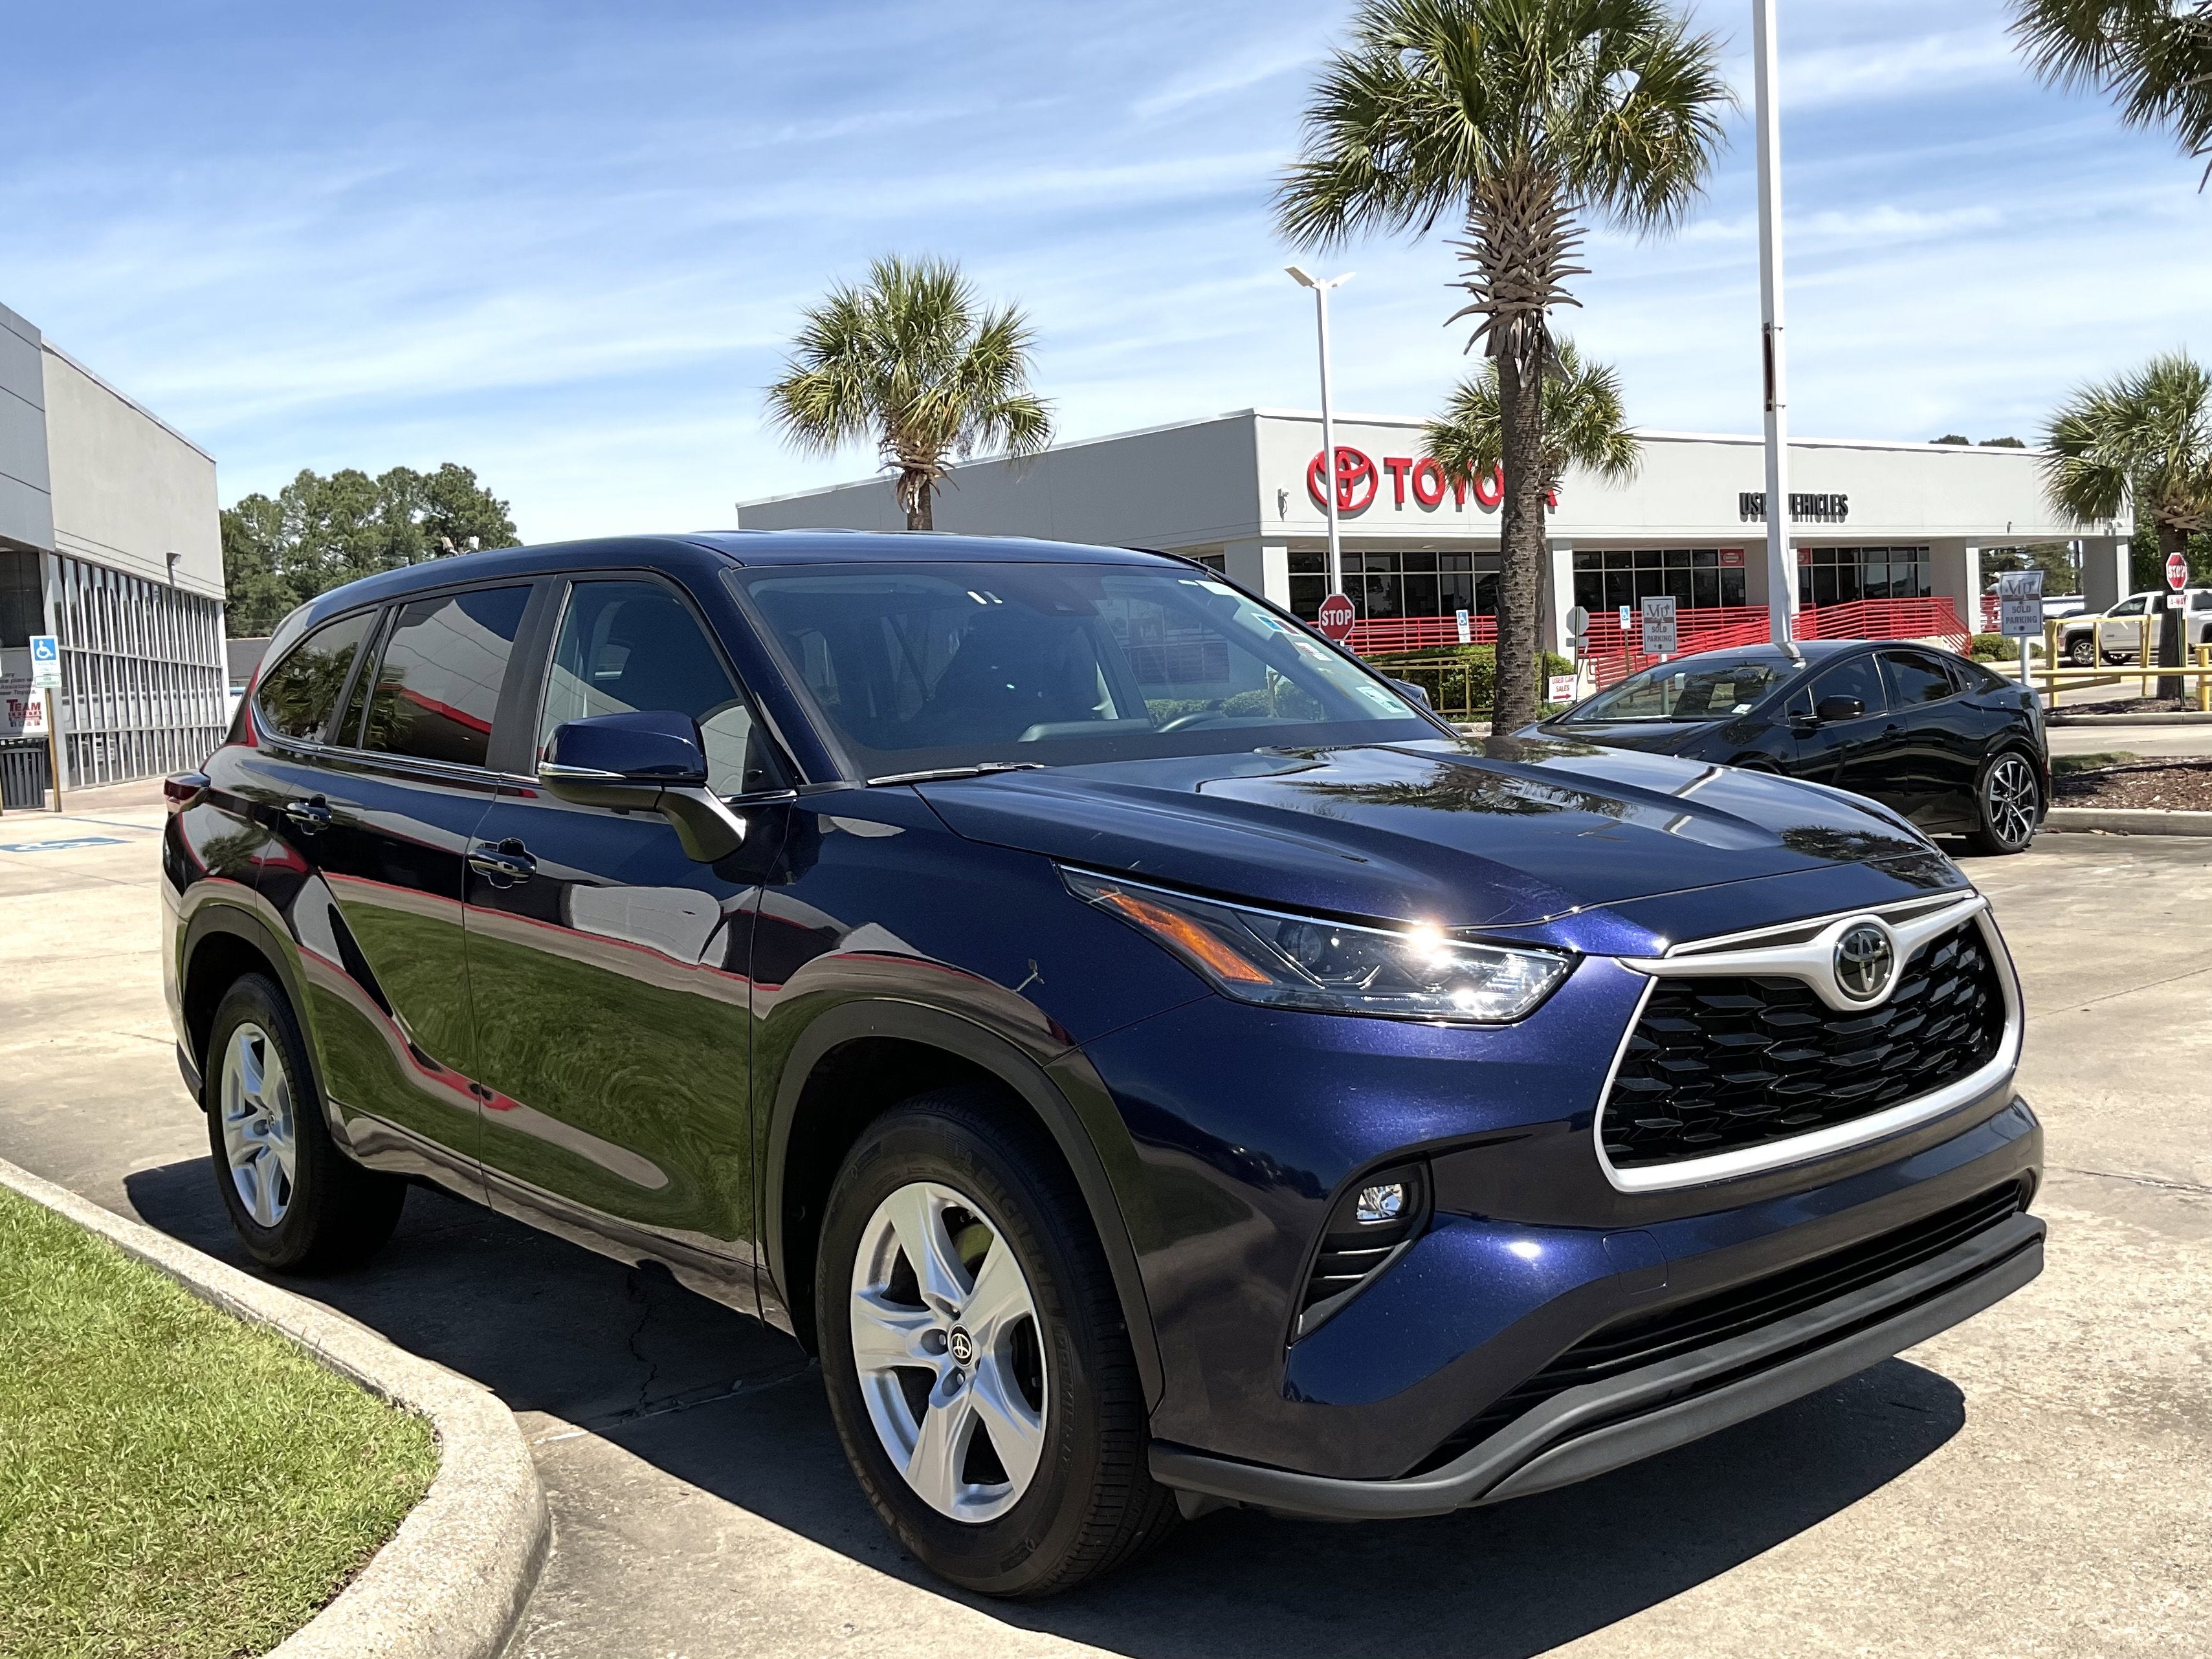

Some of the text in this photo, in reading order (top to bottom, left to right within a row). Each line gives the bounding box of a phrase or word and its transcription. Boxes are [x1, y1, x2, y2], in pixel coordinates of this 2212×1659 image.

[1384, 457, 1558, 506] TOYO
[2168, 565, 2185, 578] STOP
[2012, 606, 2031, 614] SOLD
[1322, 610, 1352, 626] STOP
[2006, 616, 2037, 624] PARKING
[6, 699, 41, 712] TEAM
